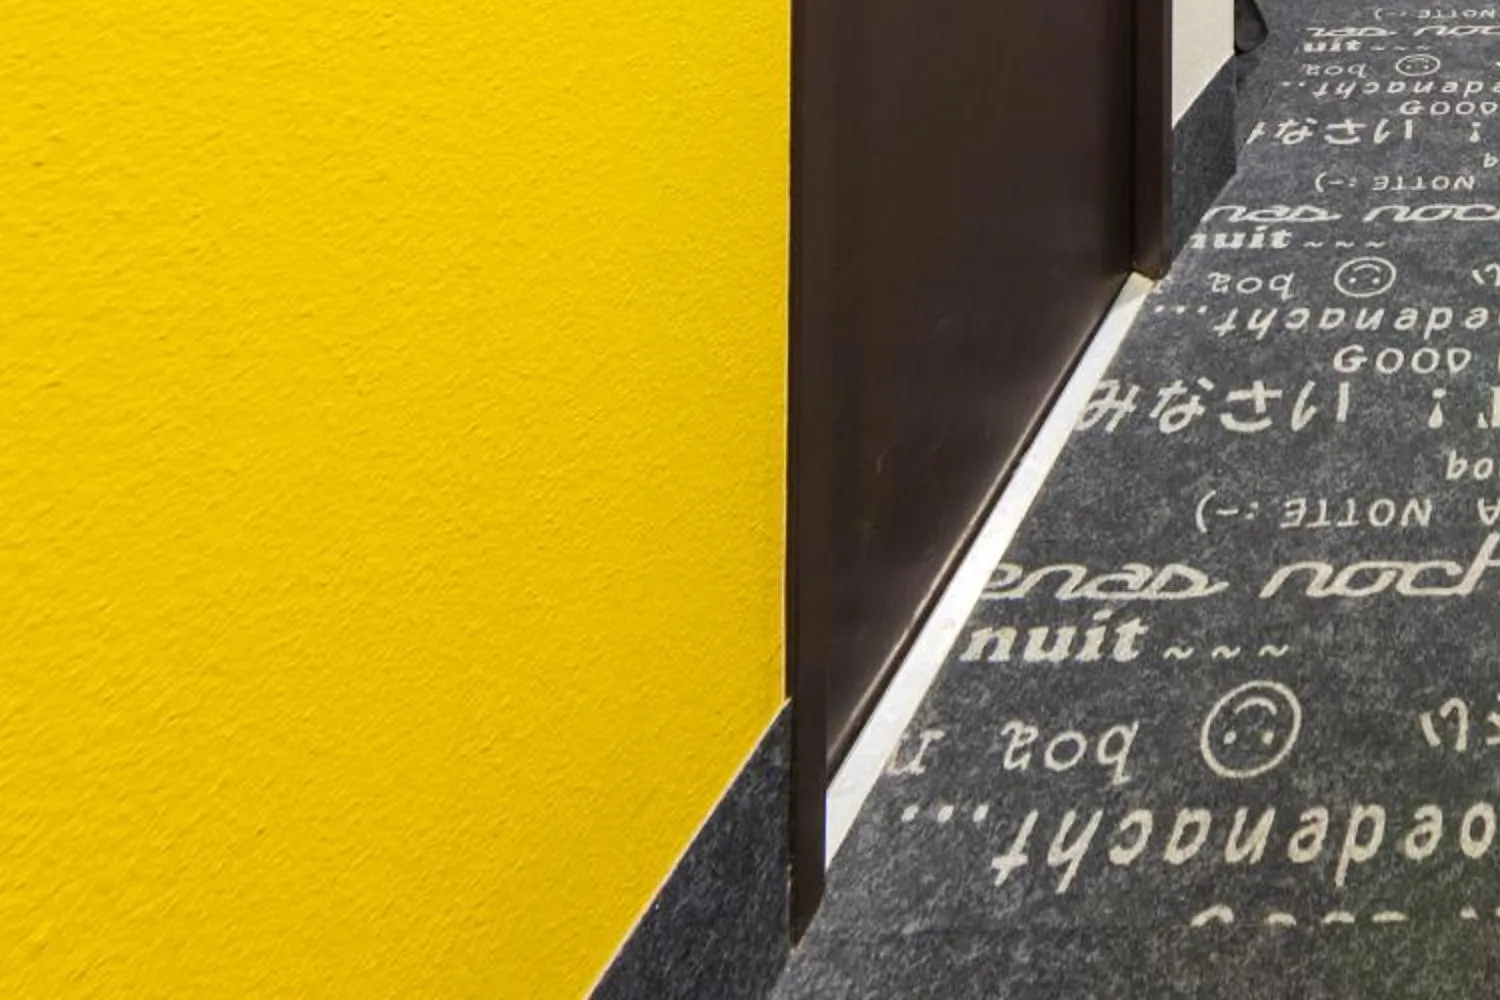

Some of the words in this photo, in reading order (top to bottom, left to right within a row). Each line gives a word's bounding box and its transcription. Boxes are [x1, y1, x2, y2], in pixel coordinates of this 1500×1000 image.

[1399, 101, 1498, 116] GOOD
[1209, 273, 1296, 301] boa
[1332, 345, 1473, 375] GOOD
[961, 609, 1149, 662] nuit
[1001, 720, 1140, 784] boa
